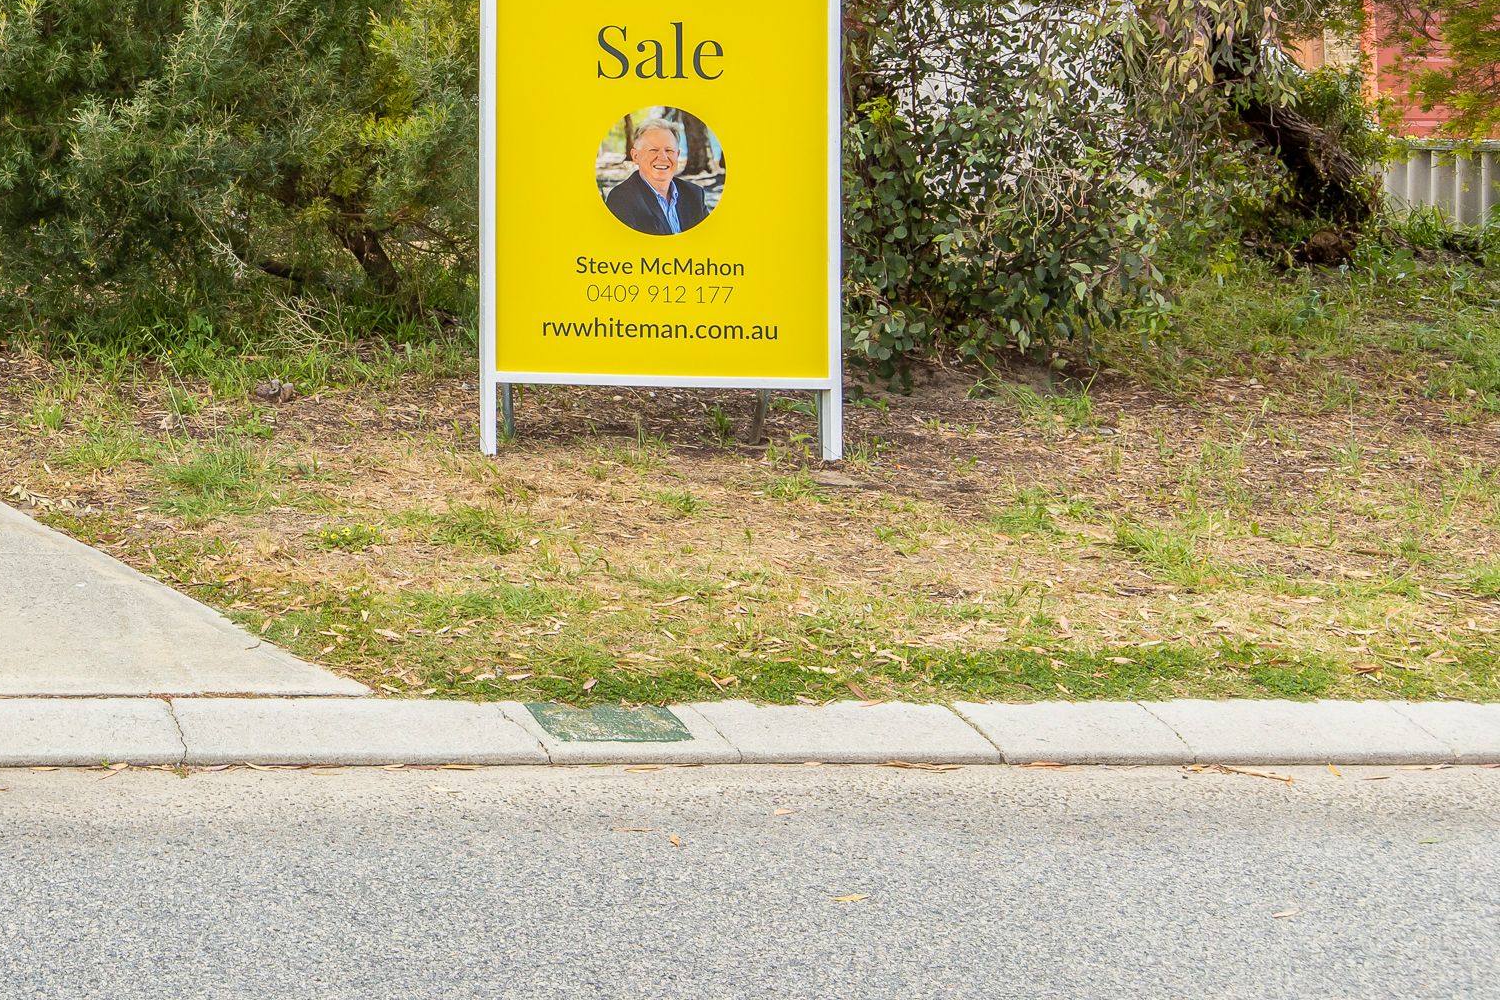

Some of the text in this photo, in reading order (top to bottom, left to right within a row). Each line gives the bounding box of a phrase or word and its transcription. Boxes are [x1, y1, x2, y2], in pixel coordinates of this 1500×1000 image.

[597, 21, 724, 80] Sale
[575, 256, 745, 277] Steve McMahon
[586, 284, 734, 304] 0409 912 177
[542, 317, 779, 340] rwwhiteman.com.au
